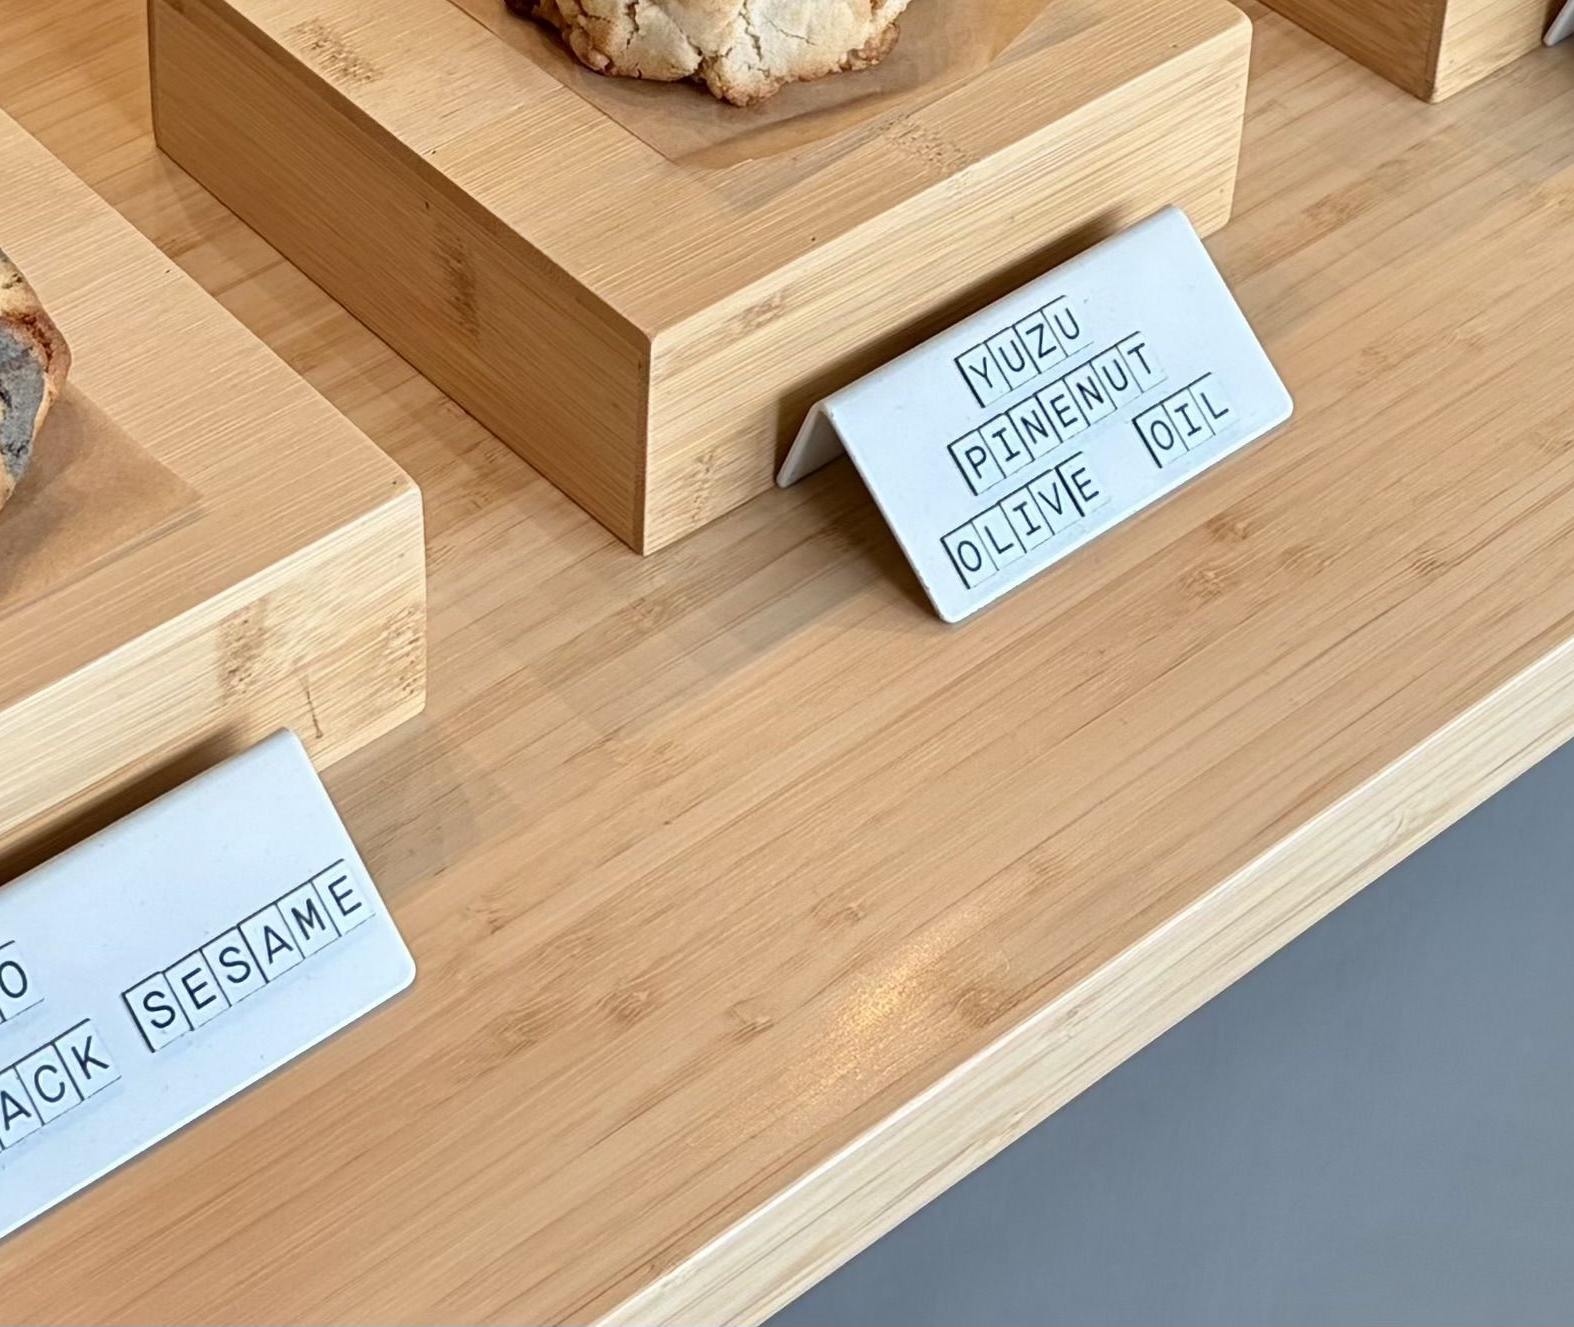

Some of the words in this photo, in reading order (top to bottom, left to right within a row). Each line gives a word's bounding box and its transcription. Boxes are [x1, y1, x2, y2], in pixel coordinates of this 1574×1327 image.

[965, 341, 1154, 480] PINENUT
[968, 306, 1082, 390] YUZU
[955, 465, 1101, 573] OLIVE
[1148, 390, 1231, 452] OIL
[140, 873, 365, 1031] SESAME
